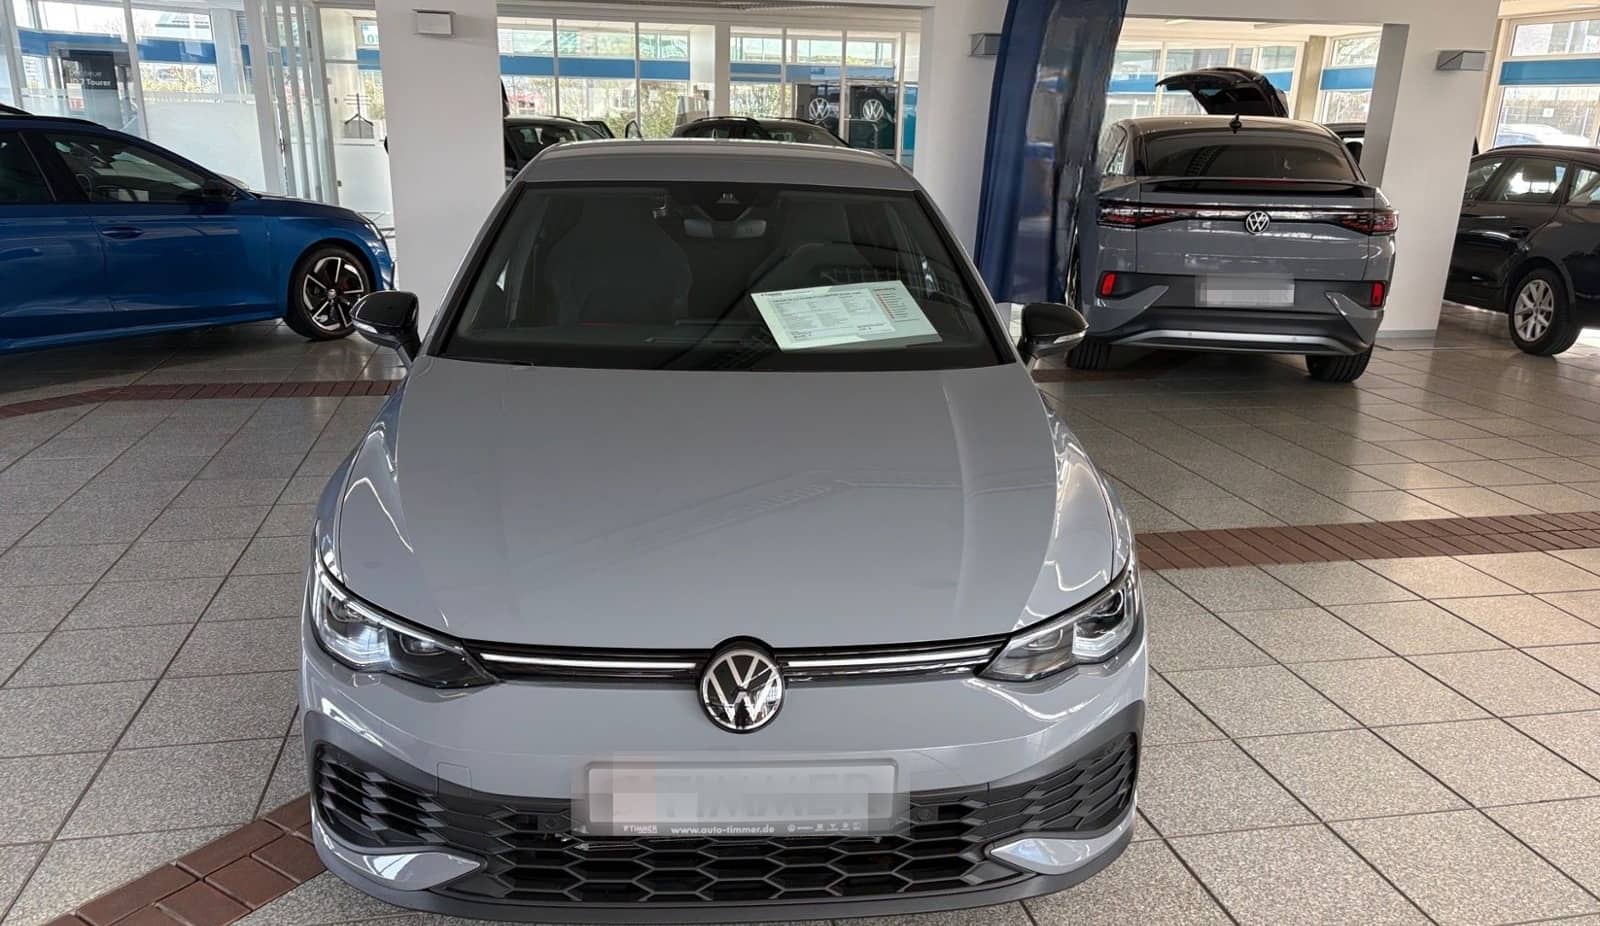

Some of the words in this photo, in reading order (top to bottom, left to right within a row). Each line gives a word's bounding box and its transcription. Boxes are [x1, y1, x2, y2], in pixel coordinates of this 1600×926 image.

[809, 97, 830, 121] VW
[862, 99, 884, 122] VW
[1246, 211, 1270, 233] VW
[702, 649, 783, 730] VW
[671, 823, 775, 835] www.auto-timmer.de
